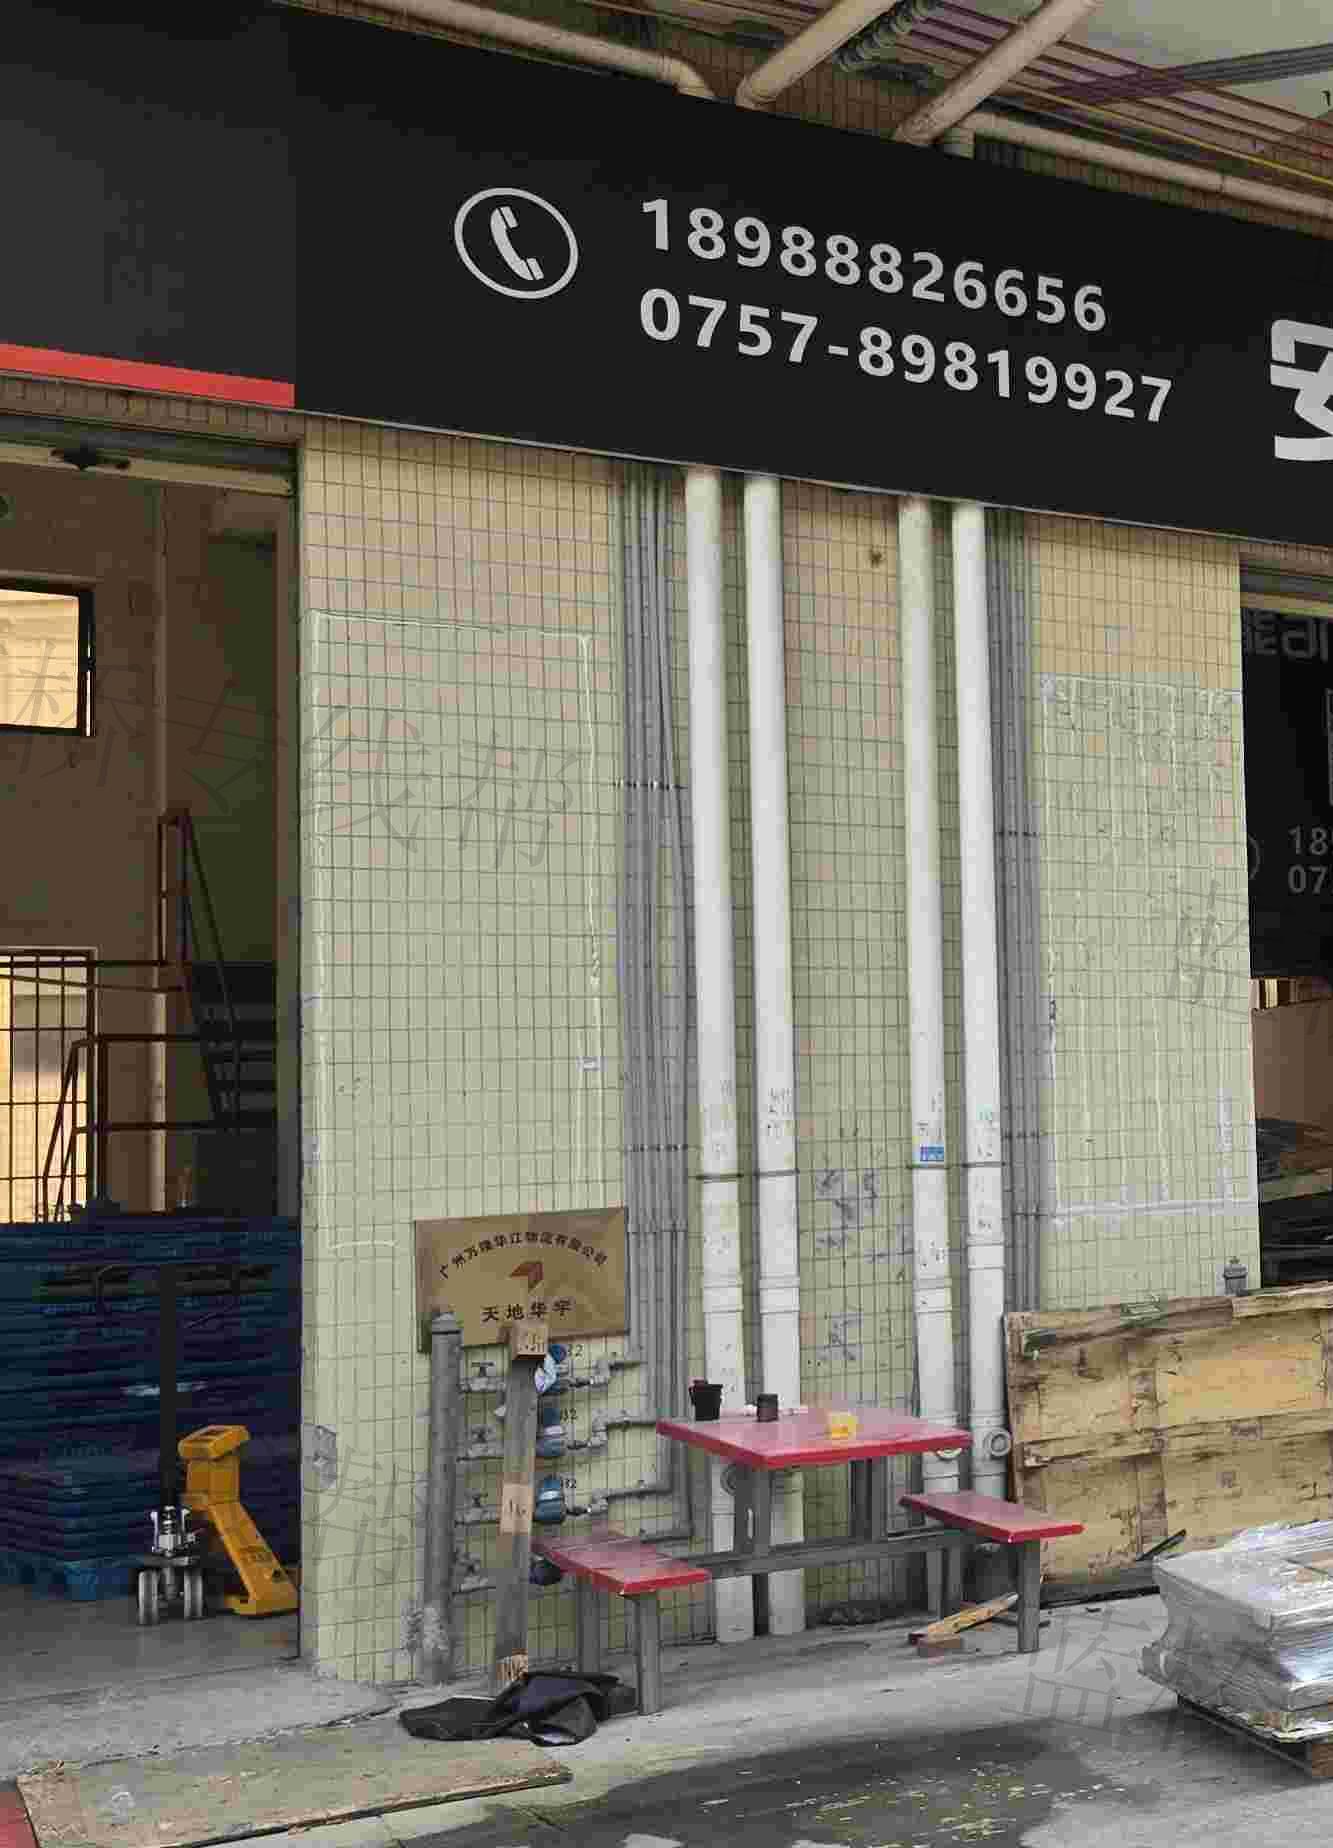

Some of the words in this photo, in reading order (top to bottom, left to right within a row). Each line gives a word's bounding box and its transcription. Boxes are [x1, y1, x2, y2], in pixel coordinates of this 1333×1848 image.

[642, 198, 1107, 333] 18988826656
[640, 287, 1173, 424] 0757-89819927
[481, 1299, 574, 1323] 天地华宇
